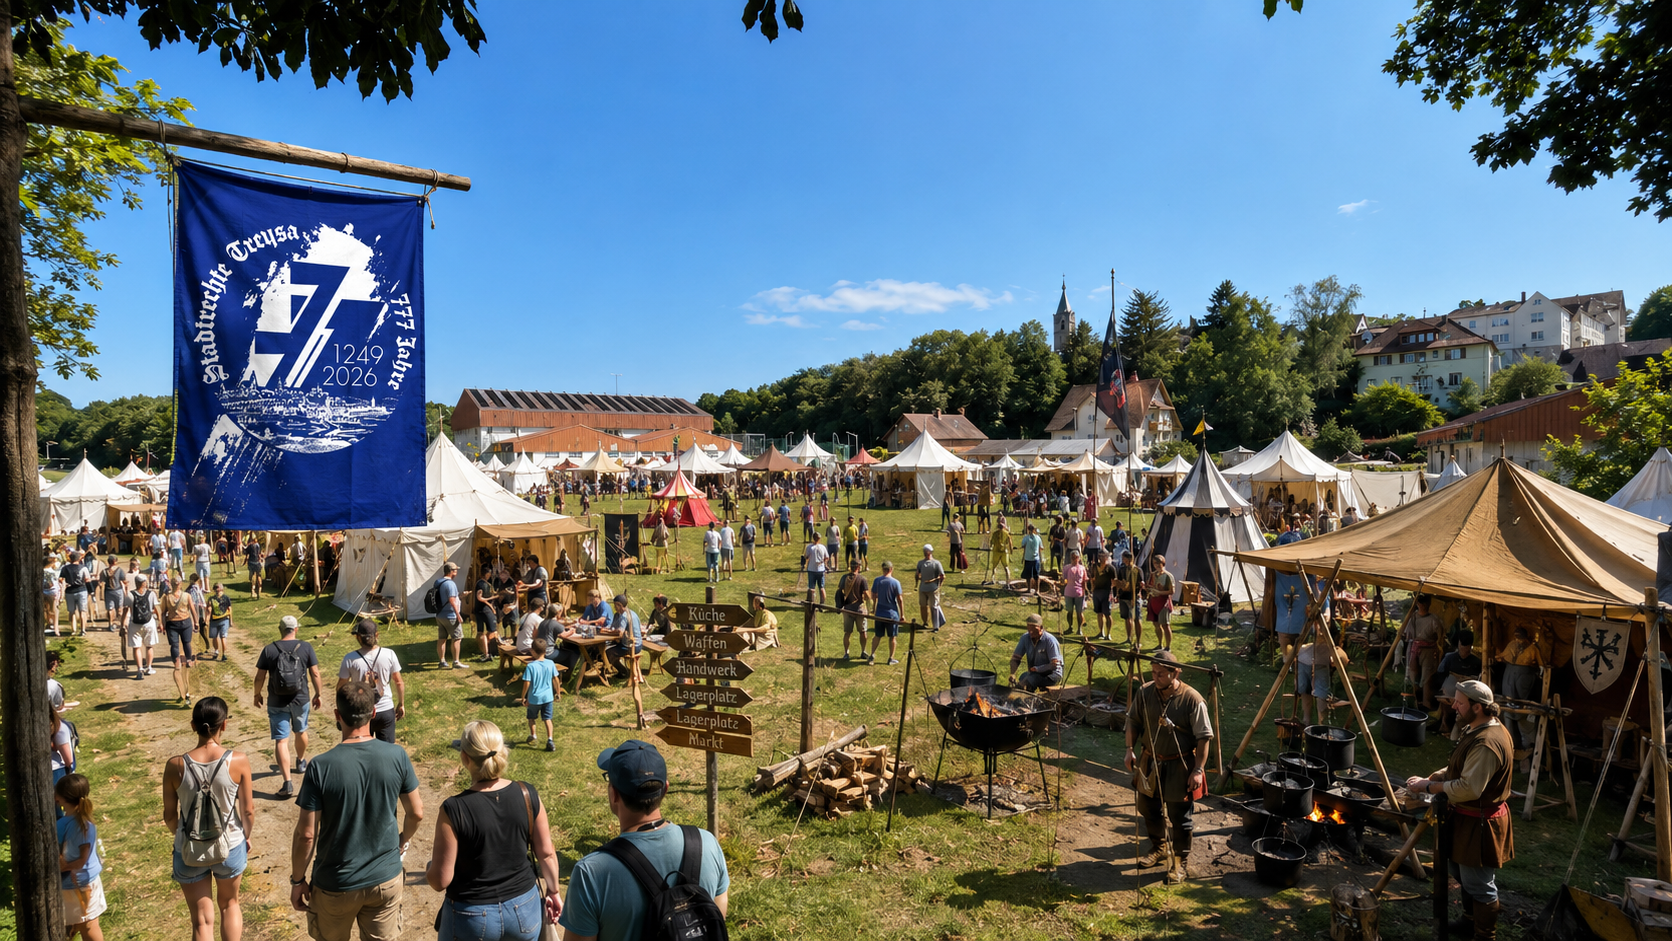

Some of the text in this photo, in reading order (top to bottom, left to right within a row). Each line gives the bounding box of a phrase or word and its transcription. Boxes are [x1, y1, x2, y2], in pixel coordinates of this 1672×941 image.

[225, 224, 300, 262] Treysa
[387, 293, 417, 391] 777 Jahre
[333, 343, 384, 365] 1249
[322, 365, 378, 387] 2026
[687, 605, 726, 622] Küche
[683, 633, 727, 652] Waffen
[676, 686, 738, 705] Lagerplatz
[688, 732, 724, 749] Markt
